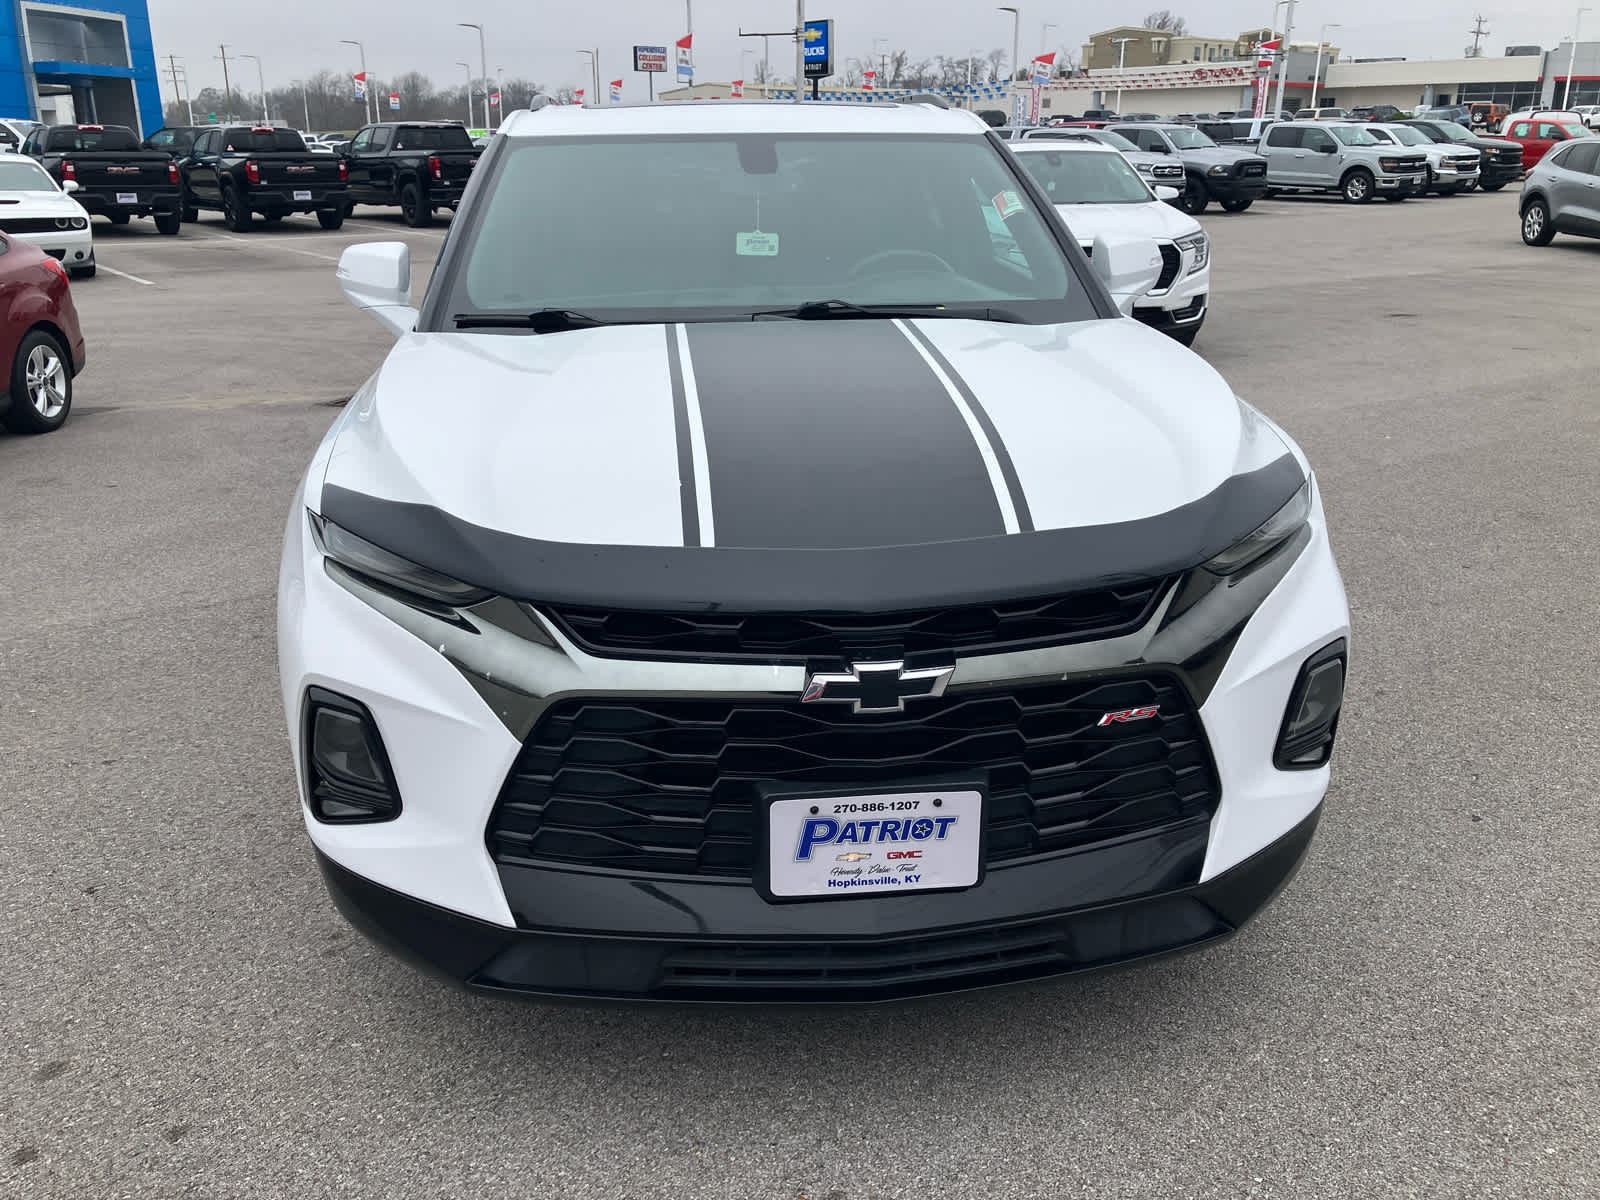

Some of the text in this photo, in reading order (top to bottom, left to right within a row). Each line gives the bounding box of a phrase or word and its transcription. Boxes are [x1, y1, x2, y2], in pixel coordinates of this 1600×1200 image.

[804, 46, 825, 56] RUCKS
[804, 63, 822, 71] ATRIOT
[1097, 704, 1161, 727] RS
[833, 800, 921, 814] 270-886-1207
[793, 816, 959, 863] PATRIOT
[886, 850, 923, 860] GMC
[827, 874, 921, 888] Hopkinsville, KY
